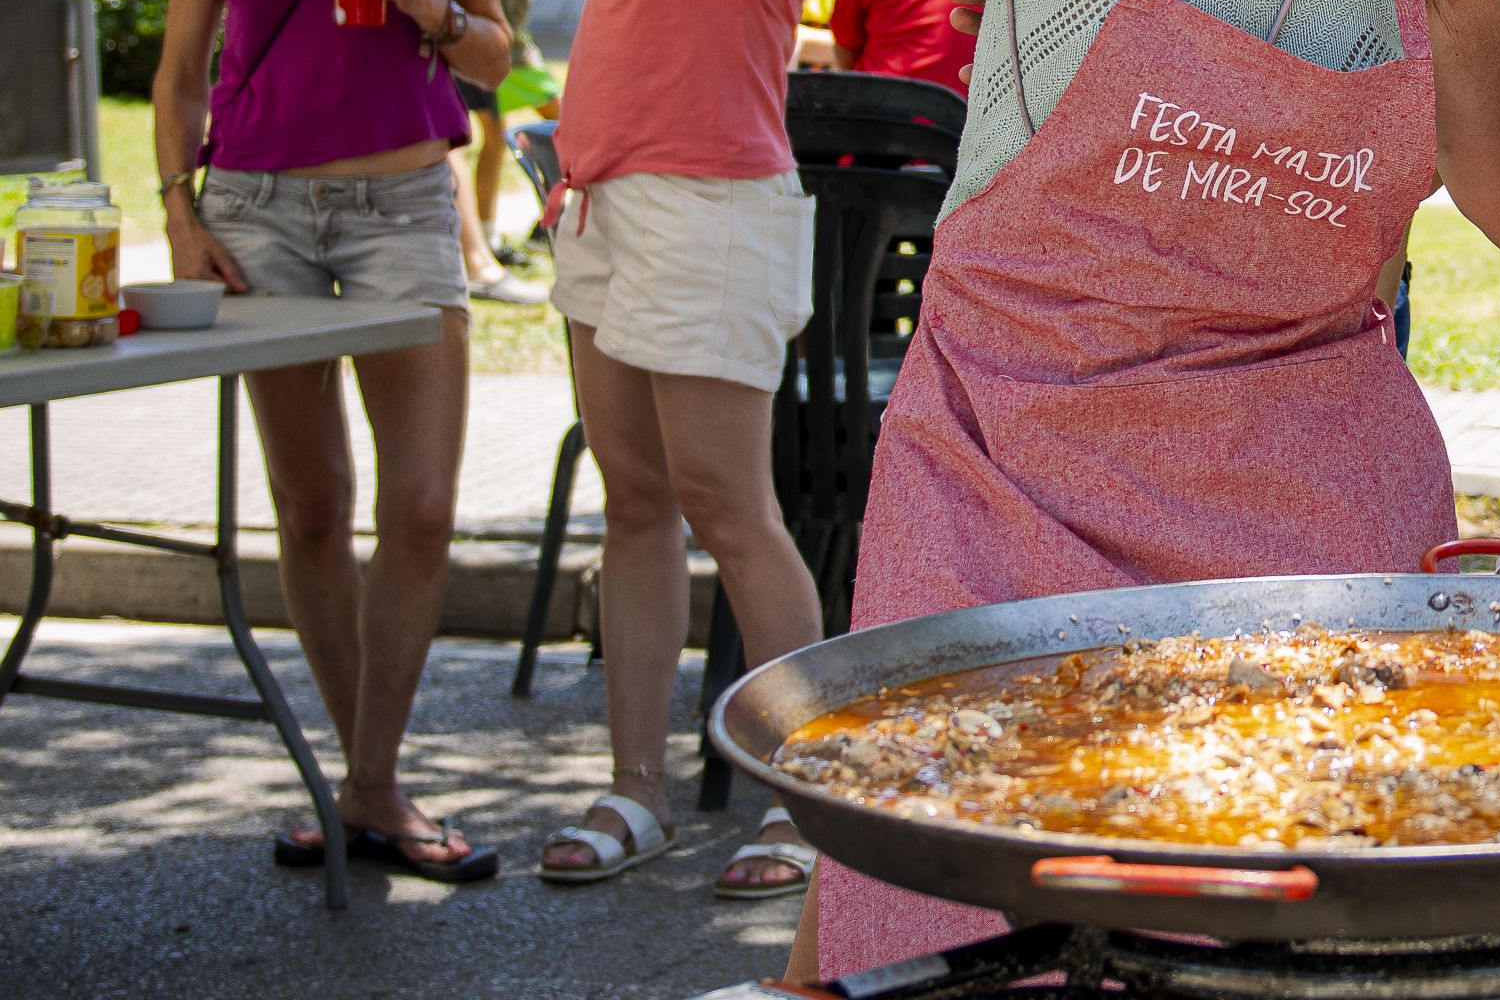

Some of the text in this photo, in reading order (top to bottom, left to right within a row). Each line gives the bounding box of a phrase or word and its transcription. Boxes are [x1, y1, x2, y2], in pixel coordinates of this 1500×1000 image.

[1113, 147, 1347, 228] DE MIRA-SOL
[1129, 92, 1375, 193] FESTA MAJOR
